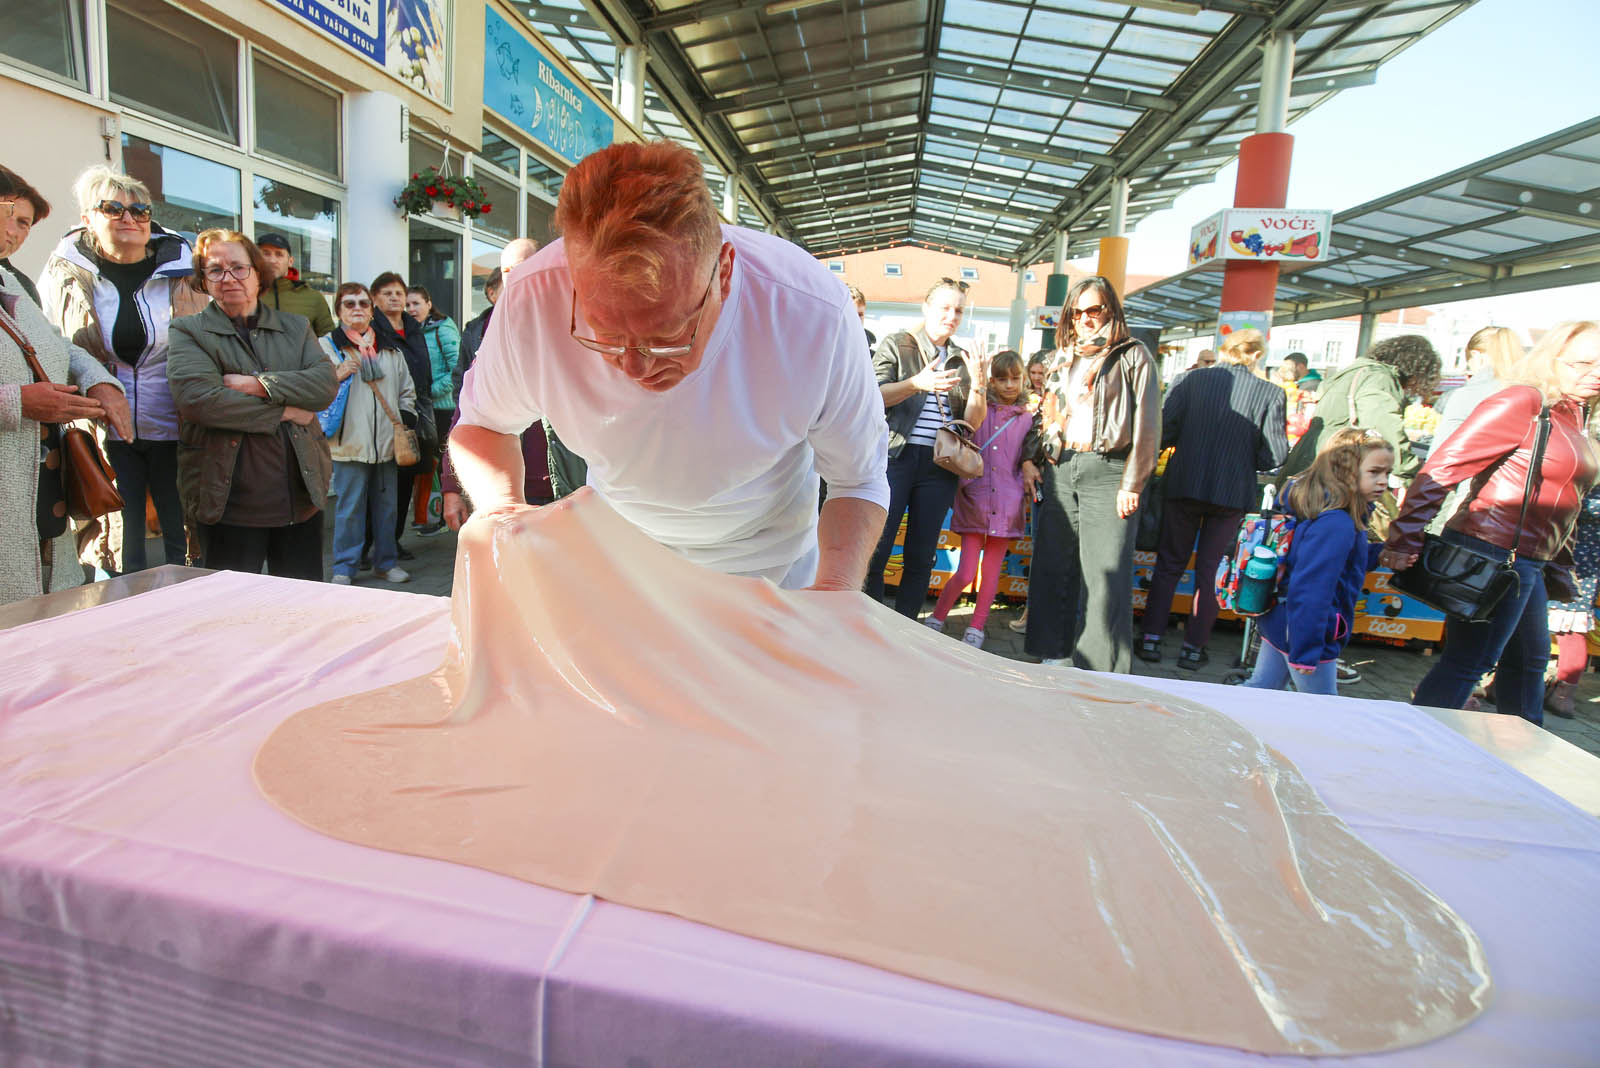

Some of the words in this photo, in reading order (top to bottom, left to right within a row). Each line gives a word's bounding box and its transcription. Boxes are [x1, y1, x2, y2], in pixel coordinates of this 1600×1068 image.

[308, 4, 321, 21] NA
[323, 14, 350, 38] VAŠEM
[352, 32, 375, 54] STOLU
[538, 60, 583, 113] Ribarnica
[1260, 215, 1317, 231] VOĆE
[1368, 618, 1407, 634] toco
